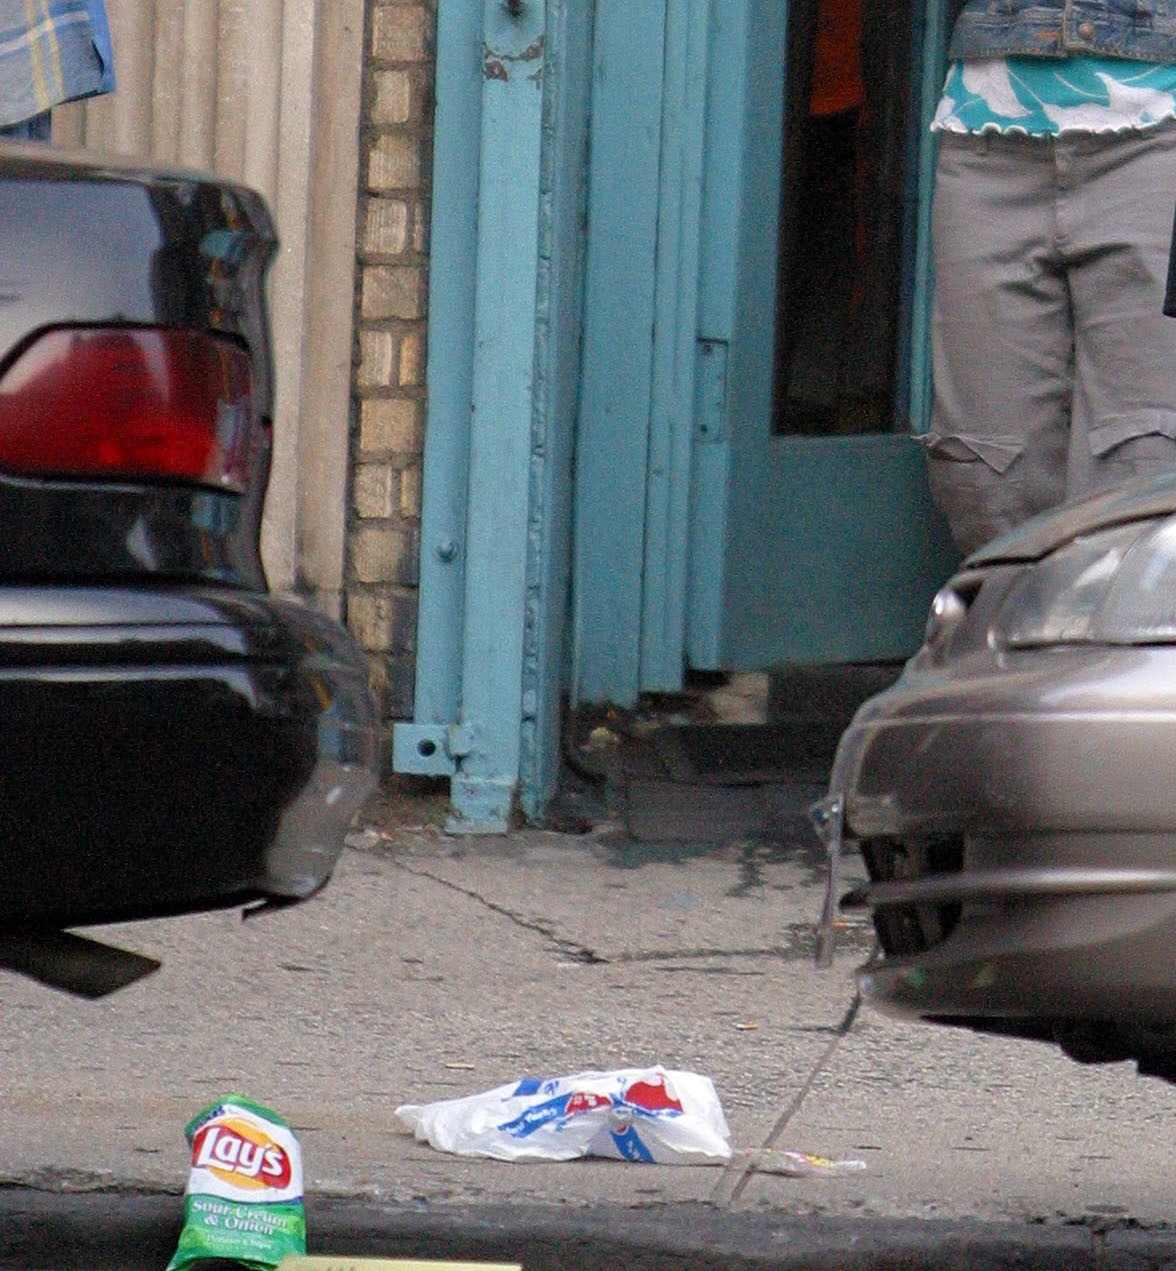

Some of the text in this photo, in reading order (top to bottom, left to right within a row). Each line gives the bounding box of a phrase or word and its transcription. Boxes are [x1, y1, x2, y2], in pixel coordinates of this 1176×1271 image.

[197, 1126, 285, 1178] Lay's
[192, 1200, 231, 1215] Sour
[205, 1214, 275, 1236] & Onion
